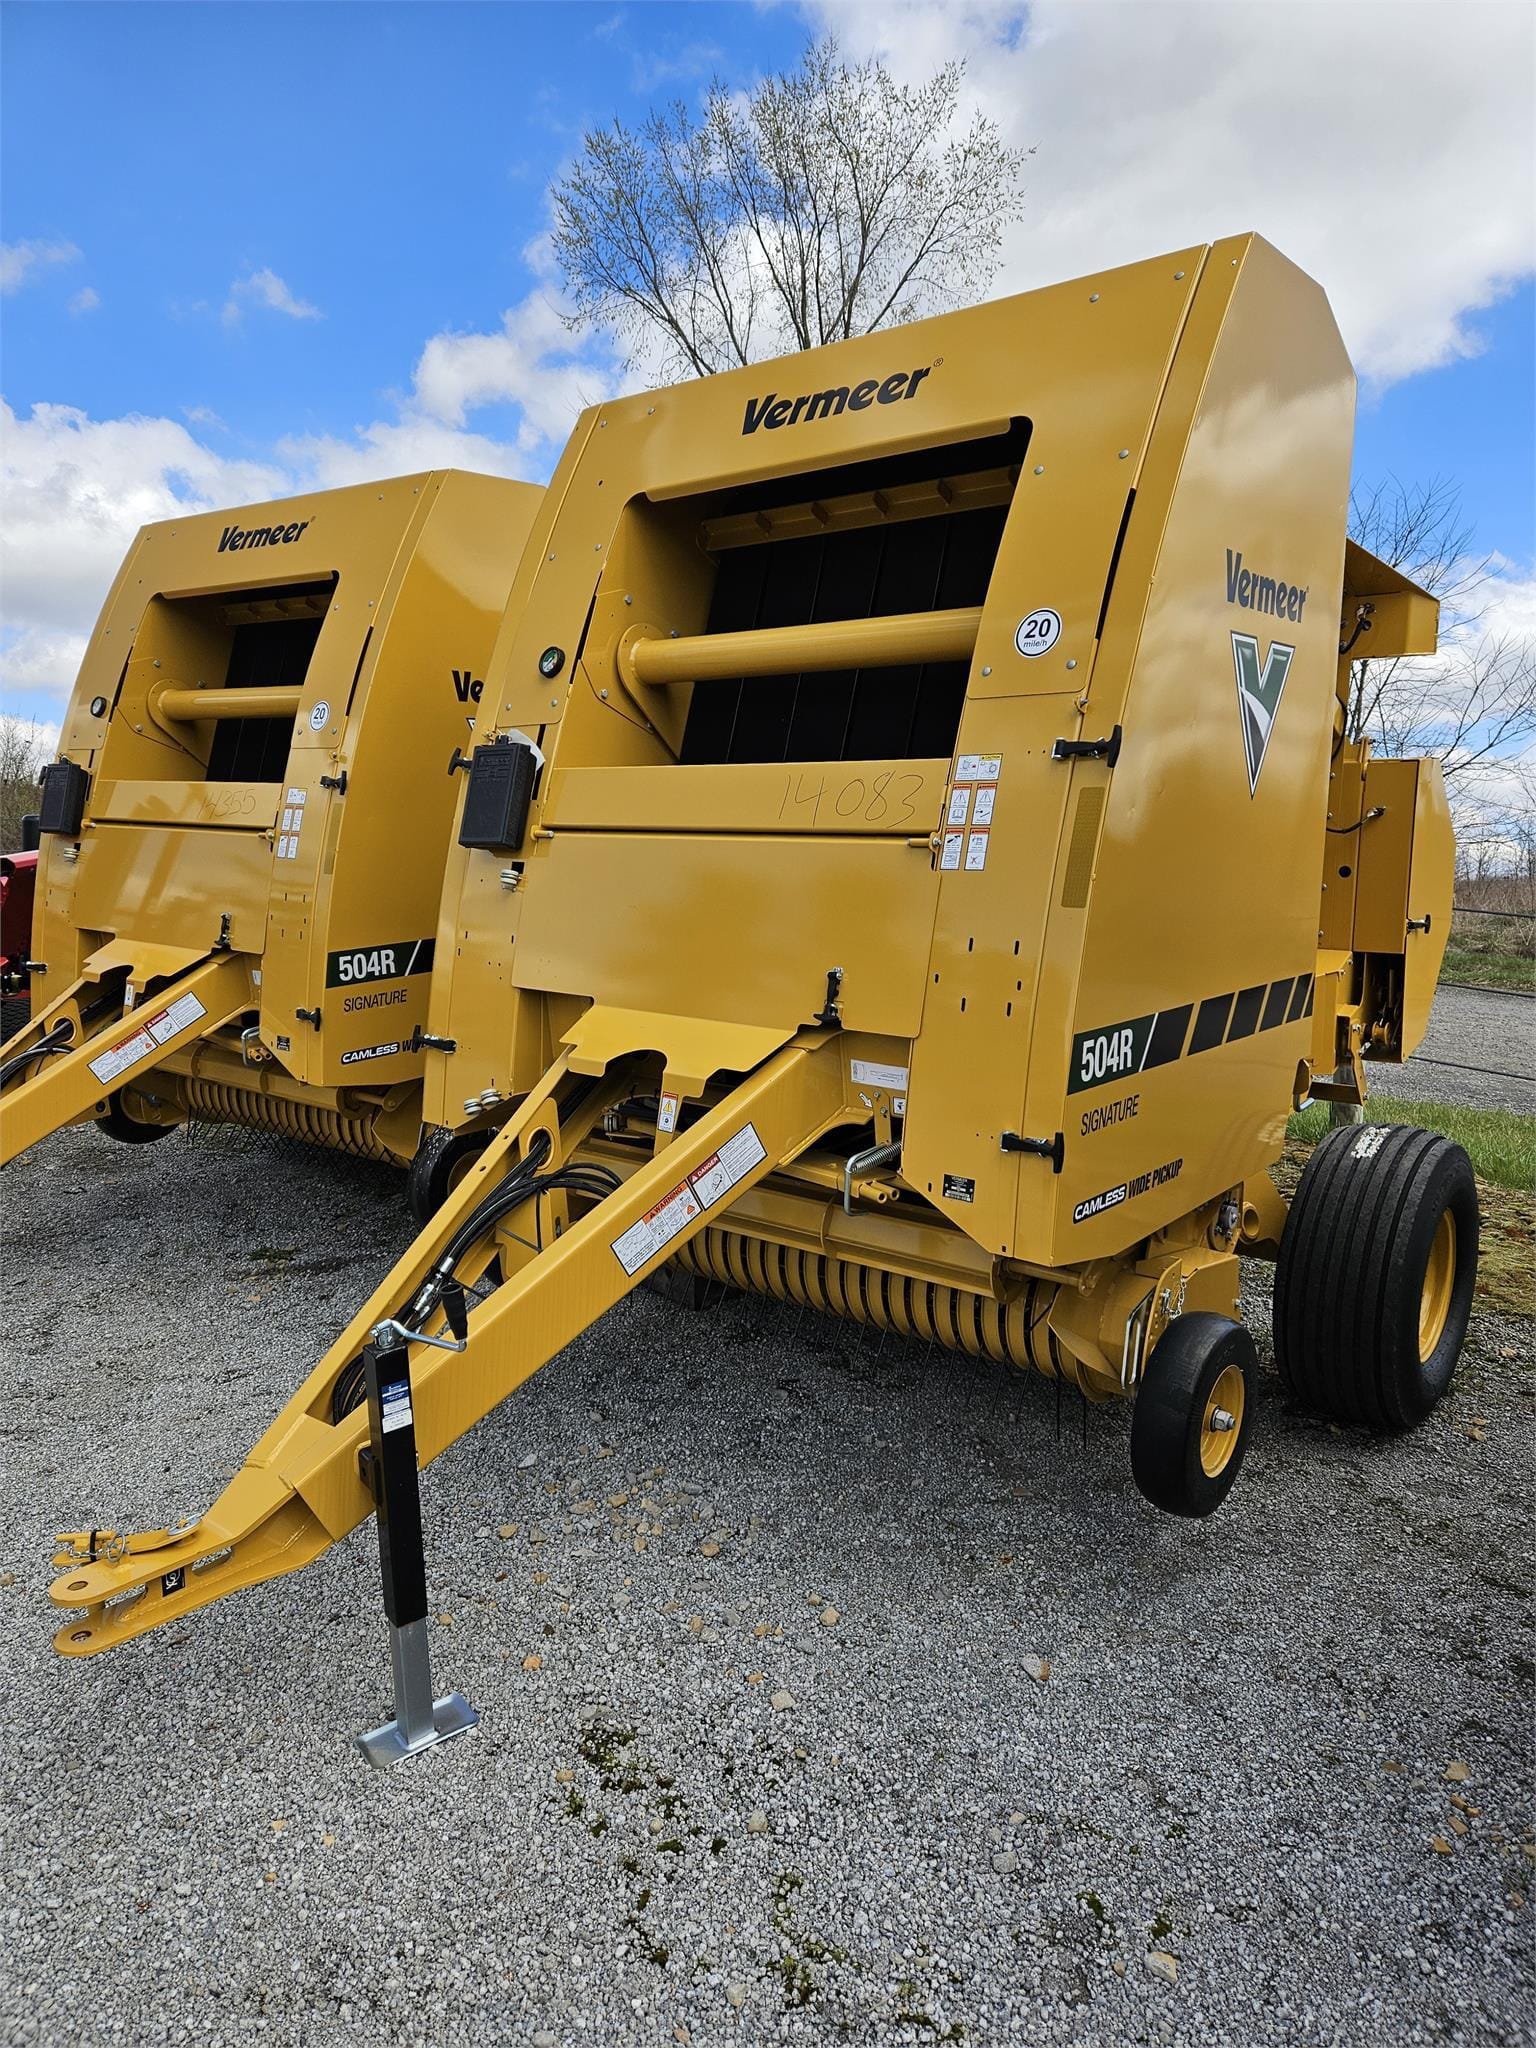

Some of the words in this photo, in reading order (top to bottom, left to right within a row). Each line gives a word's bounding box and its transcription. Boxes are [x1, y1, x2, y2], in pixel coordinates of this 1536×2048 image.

[217, 520, 310, 553] Vermeer
[1226, 547, 1307, 623] Vermeer
[1023, 618, 1051, 639] 20
[1023, 640, 1048, 648] mile/h
[313, 707, 326, 720] 20
[197, 789, 257, 819] 14355
[778, 770, 924, 828] 14083
[339, 949, 397, 981] 504R
[343, 988, 408, 1013] SIGNATURE
[341, 1042, 399, 1064] CAMLESS
[1080, 1027, 1134, 1083] 504R
[1080, 1094, 1140, 1137] SIGNATURE
[654, 1186, 683, 1214] WARNING
[1074, 1185, 1126, 1221] CAMLESS
[1127, 1171, 1152, 1199] WIDE
[1151, 1158, 1184, 1188] PICKUP
